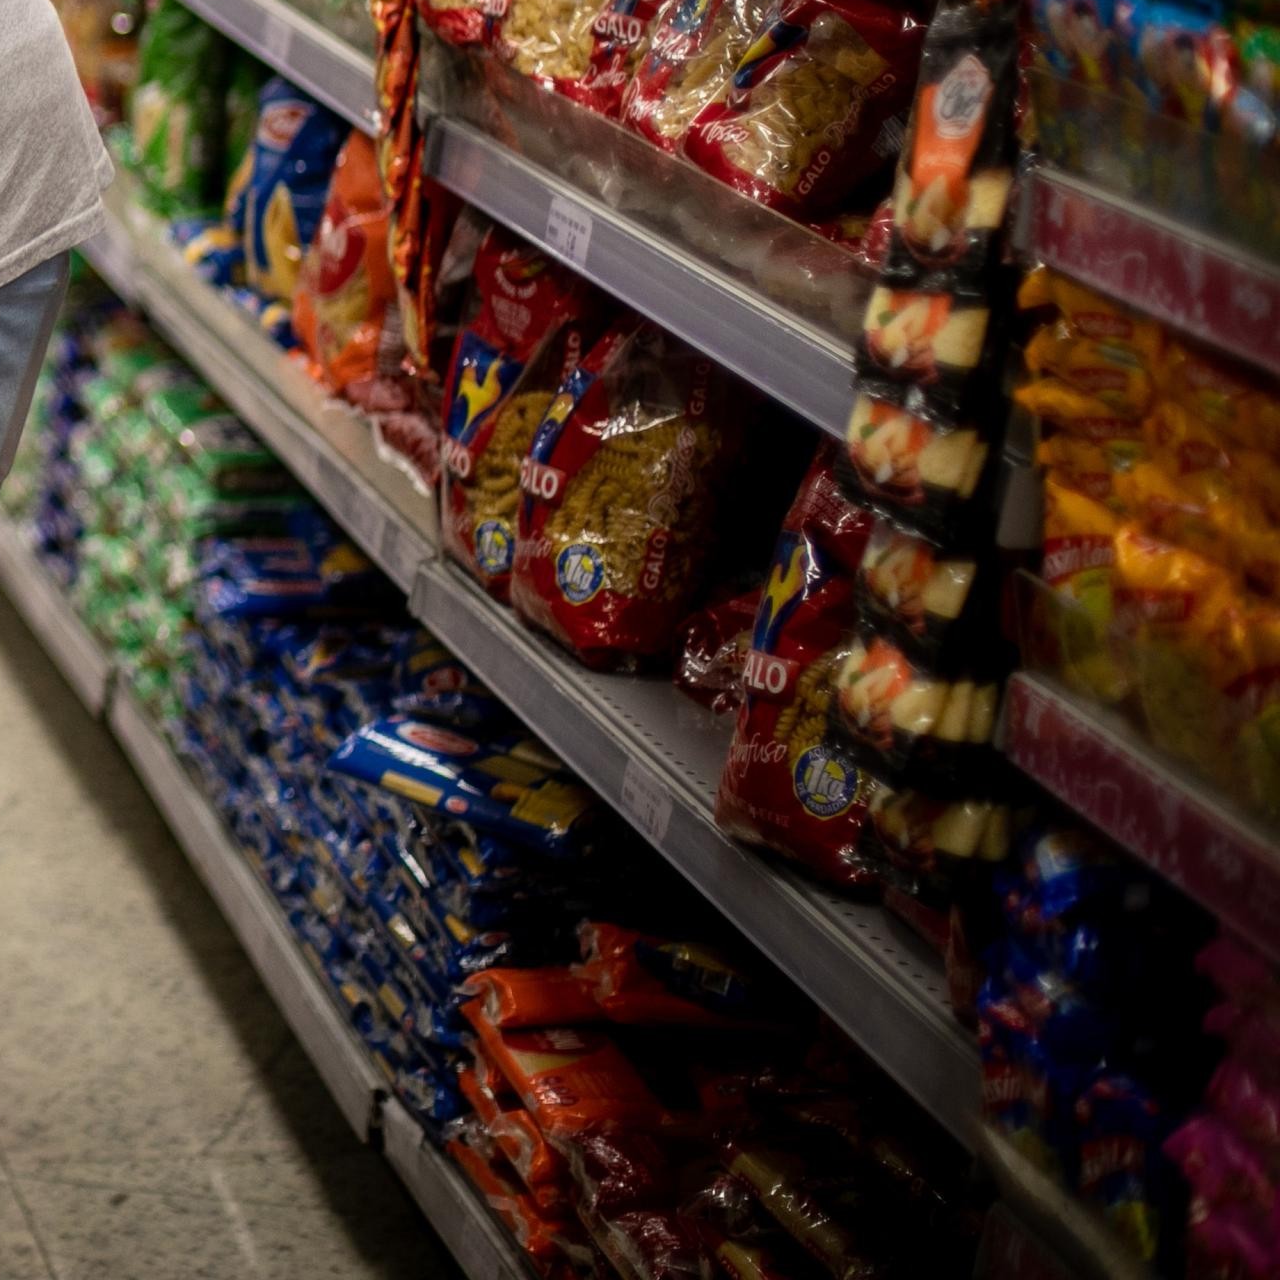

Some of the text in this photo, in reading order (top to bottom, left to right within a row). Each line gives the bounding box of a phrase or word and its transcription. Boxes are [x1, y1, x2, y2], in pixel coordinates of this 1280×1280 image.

[594, 17, 640, 44] GALO
[868, 73, 897, 99] ALO
[797, 149, 832, 196] GALO
[643, 531, 669, 590] GALO
[742, 653, 788, 695] ALO
